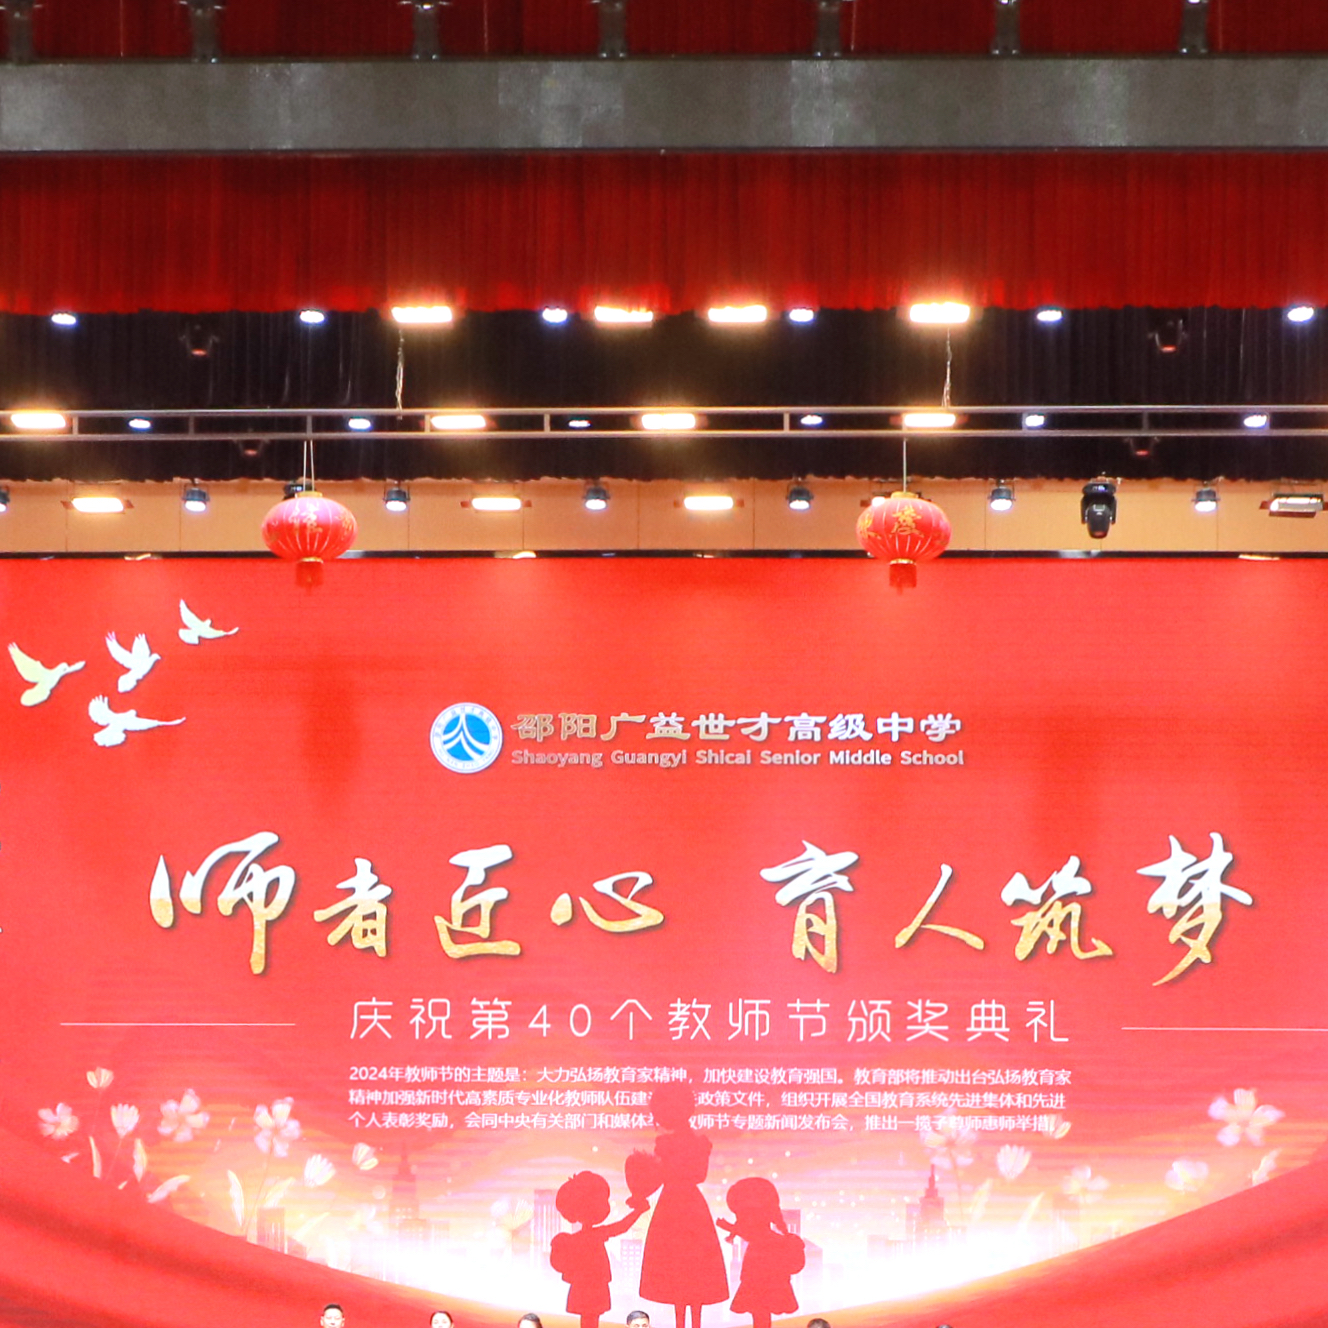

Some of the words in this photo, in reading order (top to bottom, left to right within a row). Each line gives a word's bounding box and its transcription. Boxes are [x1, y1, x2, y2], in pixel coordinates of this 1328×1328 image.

[510, 712, 963, 743] 邵阳广益世才高级中学
[511, 749, 604, 768] Shaoyang
[610, 749, 688, 768] Guangyi
[695, 749, 753, 766] Shicai
[760, 749, 822, 766] Senior
[829, 749, 893, 766] Middle
[900, 749, 965, 766] School
[150, 831, 665, 975] 师者匠心
[759, 831, 1254, 987] 育人筑梦
[350, 997, 1071, 1043] 庆祝第40个教师节颁奖典礼
